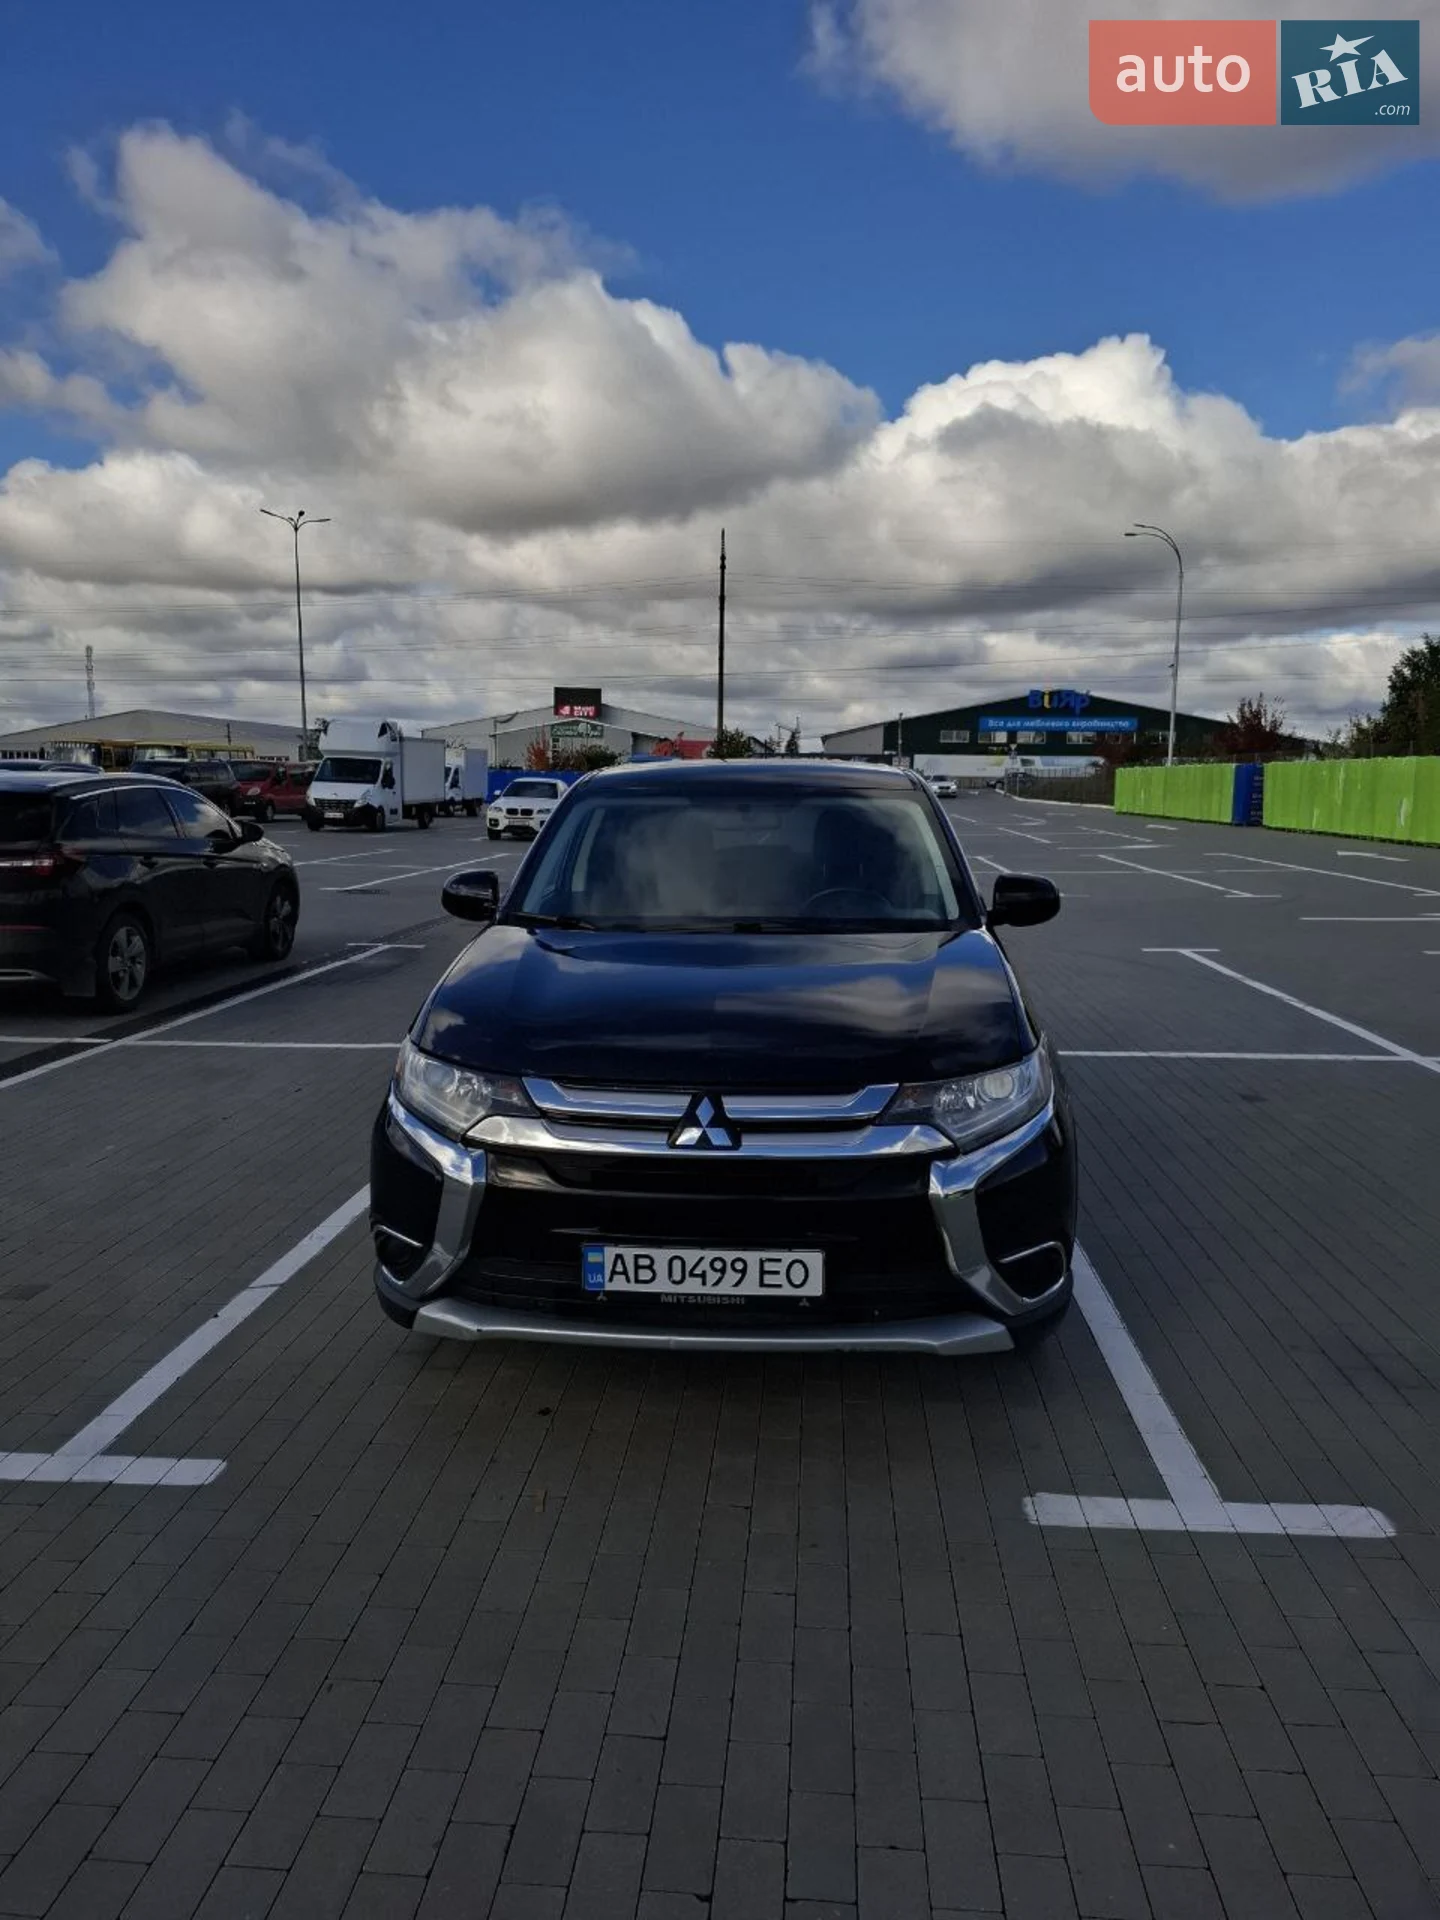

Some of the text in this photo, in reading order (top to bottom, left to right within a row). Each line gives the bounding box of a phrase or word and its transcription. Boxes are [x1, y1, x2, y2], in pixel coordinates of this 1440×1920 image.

[608, 1253, 810, 1289] AB 0499 EO
[588, 1273, 604, 1284] UA
[660, 1293, 745, 1305] MITSUBISHI
